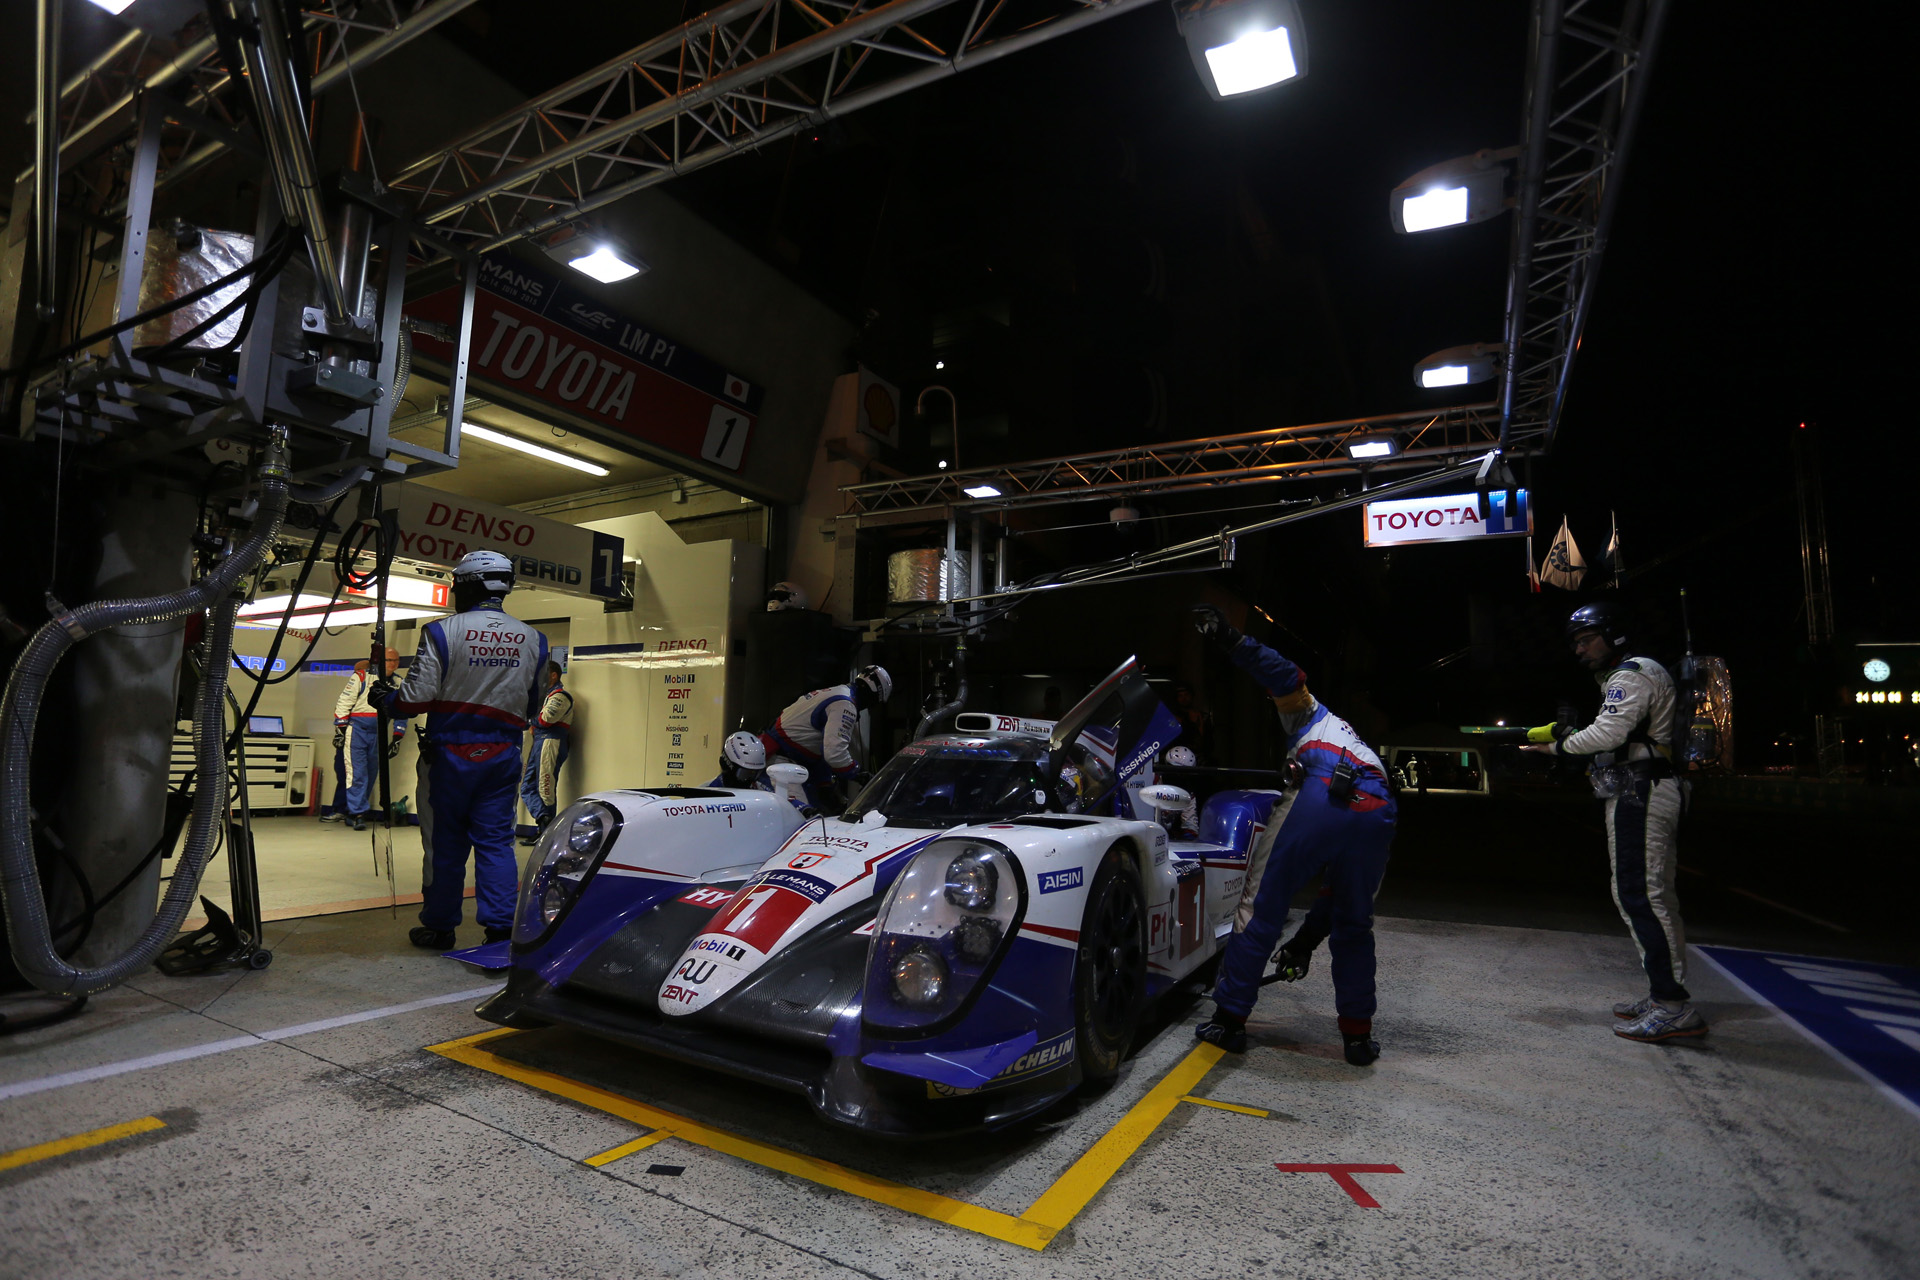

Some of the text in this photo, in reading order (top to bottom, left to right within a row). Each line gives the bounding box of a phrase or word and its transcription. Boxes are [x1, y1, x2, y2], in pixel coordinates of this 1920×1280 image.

[481, 258, 544, 297] MANS
[502, 284, 519, 297] JUIN
[520, 292, 538, 306] 2015
[571, 302, 617, 329] WEC
[618, 323, 677, 368] LM P1
[477, 310, 637, 422] TOYOTA
[715, 417, 737, 459] 1
[425, 502, 535, 547] DENSO
[1373, 507, 1479, 531] TOYOTA
[456, 573, 485, 583] uvex
[599, 549, 615, 590] 1
[436, 588, 444, 603] 1
[465, 629, 526, 645] DENSO
[469, 645, 520, 659] TOYOTA
[469, 657, 520, 668] HYBRID
[664, 674, 687, 684] Mobil
[667, 688, 692, 699] ZENT
[997, 716, 1020, 732] ZENT
[1119, 741, 1160, 779] NISSHINBO
[1155, 792, 1174, 801] Mobil
[663, 803, 746, 817] TOYOTA HYBRID
[727, 814, 733, 828] 1
[809, 836, 869, 849] TOYOTA
[769, 873, 783, 882] LE
[784, 876, 826, 896] MANS
[1043, 871, 1081, 890] AISIN
[1224, 877, 1242, 892] TOYOTA
[724, 885, 779, 933] 1
[1194, 884, 1201, 942] 1
[1151, 911, 1167, 946] P1
[689, 939, 729, 954] Mobil
[661, 984, 699, 1005] ZENT
